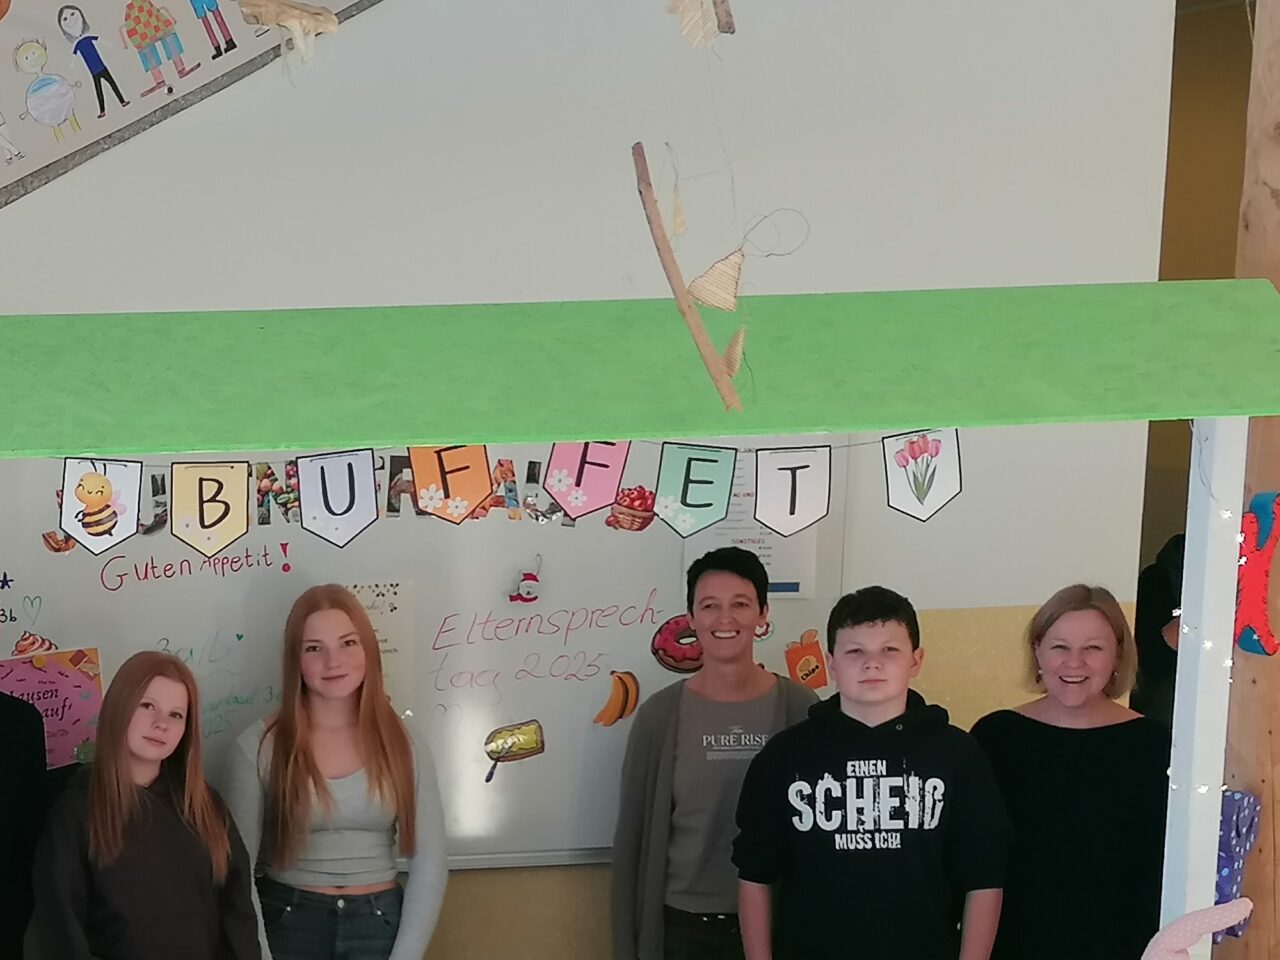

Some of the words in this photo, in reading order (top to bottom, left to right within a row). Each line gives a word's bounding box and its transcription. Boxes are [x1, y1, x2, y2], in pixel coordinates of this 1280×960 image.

[198, 443, 811, 530] BUFFET
[100, 555, 192, 591] Guten
[0, 608, 18, 623] 3b
[431, 587, 664, 650] Elternsprech-
[429, 652, 502, 705] tag
[515, 650, 609, 681] 2025
[703, 734, 738, 746] PURE
[846, 760, 887, 776] EINEN
[835, 832, 872, 850] MUSS
